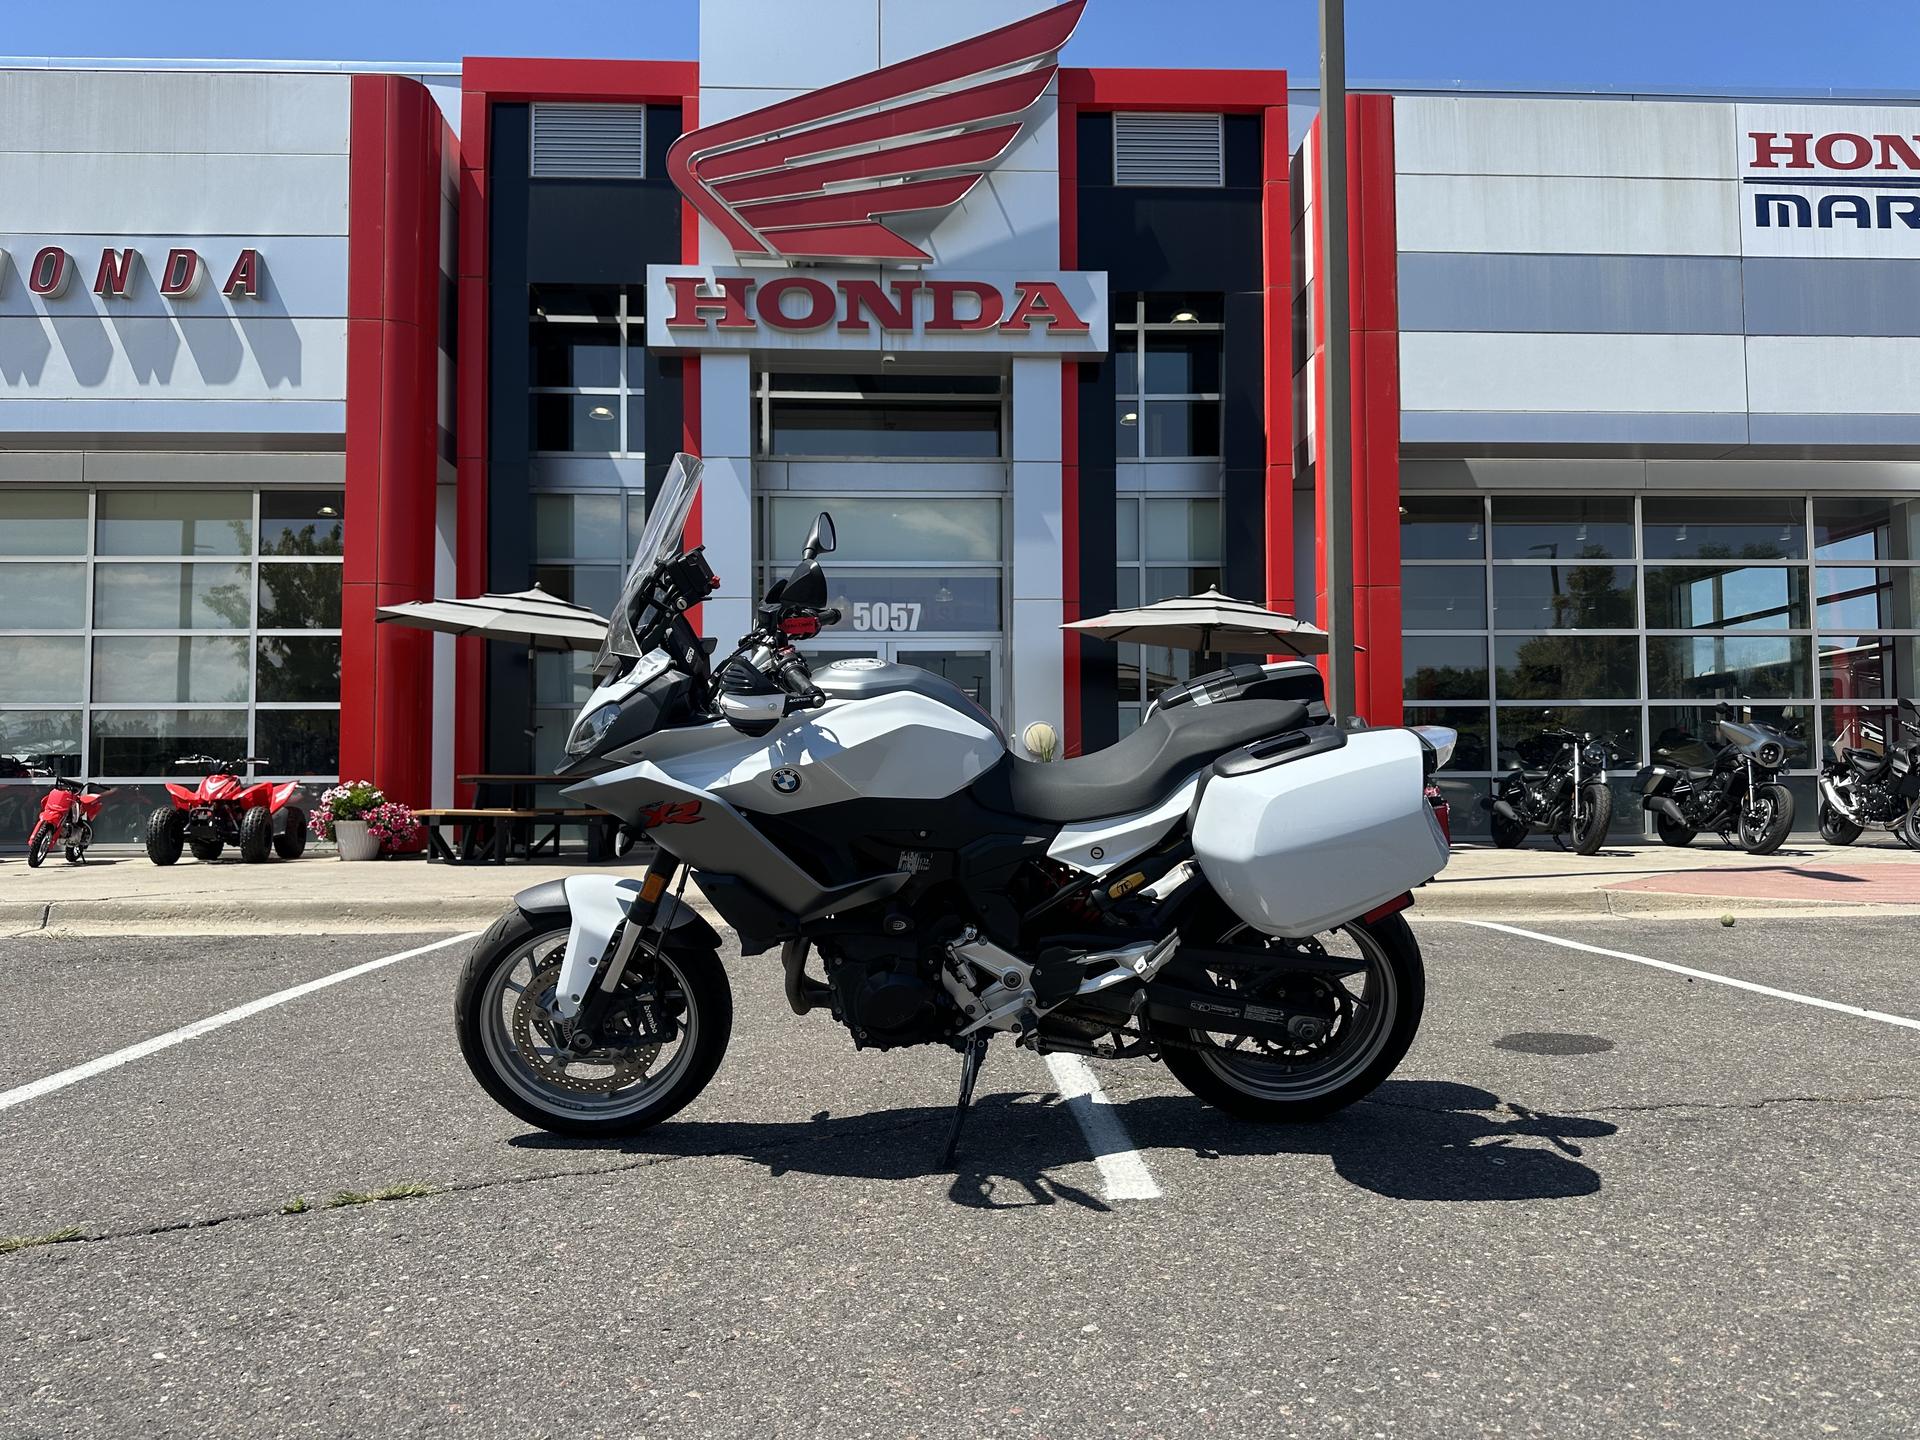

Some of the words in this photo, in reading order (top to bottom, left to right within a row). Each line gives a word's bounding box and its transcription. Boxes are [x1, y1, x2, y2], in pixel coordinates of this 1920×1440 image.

[1748, 132, 1920, 170] HON
[1754, 193, 1920, 229] MAR
[0, 246, 259, 296] ONDA
[665, 277, 1090, 335] HONDA
[853, 602, 921, 631] 5057
[643, 1004, 658, 1034] brembo
